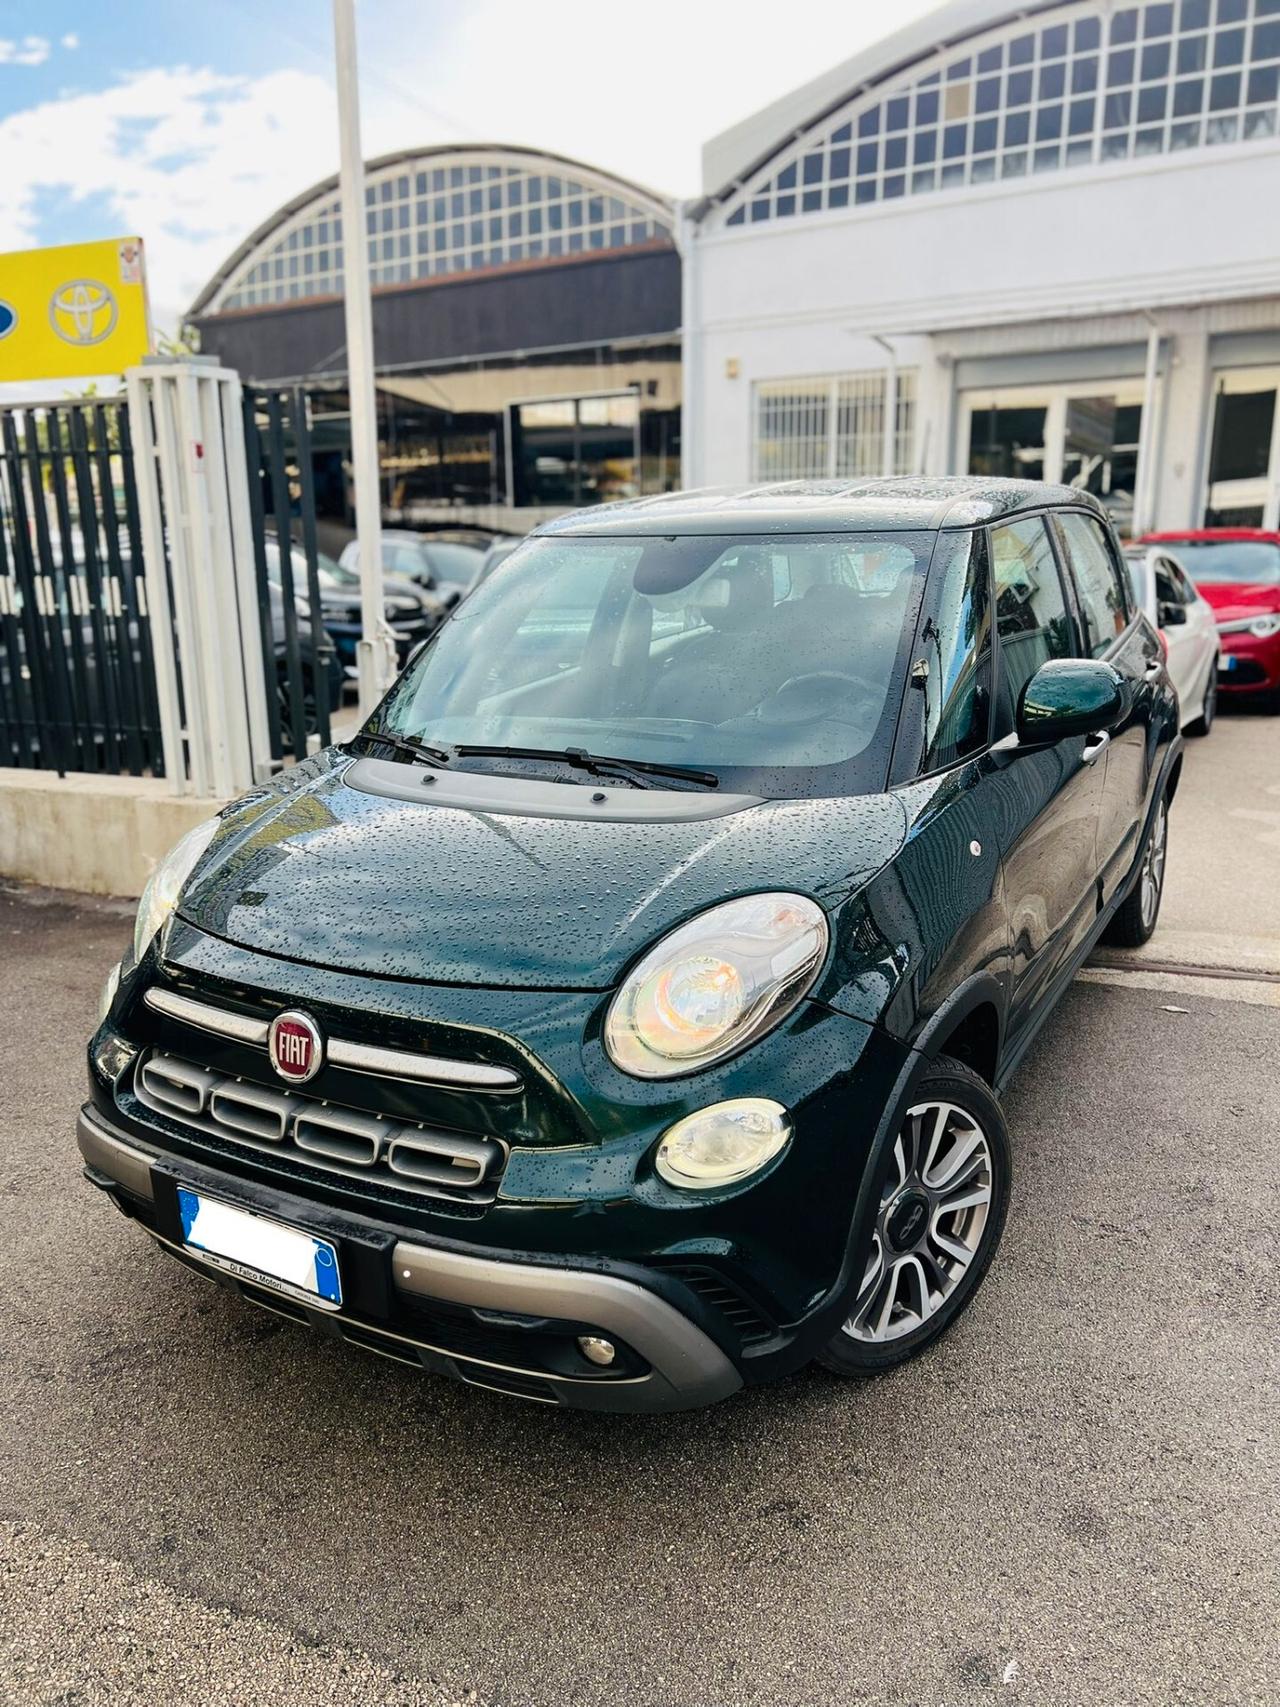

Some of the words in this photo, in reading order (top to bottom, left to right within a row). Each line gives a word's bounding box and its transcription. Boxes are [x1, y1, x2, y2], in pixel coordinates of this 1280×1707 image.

[278, 1031, 310, 1066] FIAT
[238, 1266, 258, 1280] Falco
[259, 1274, 282, 1290] Motori
